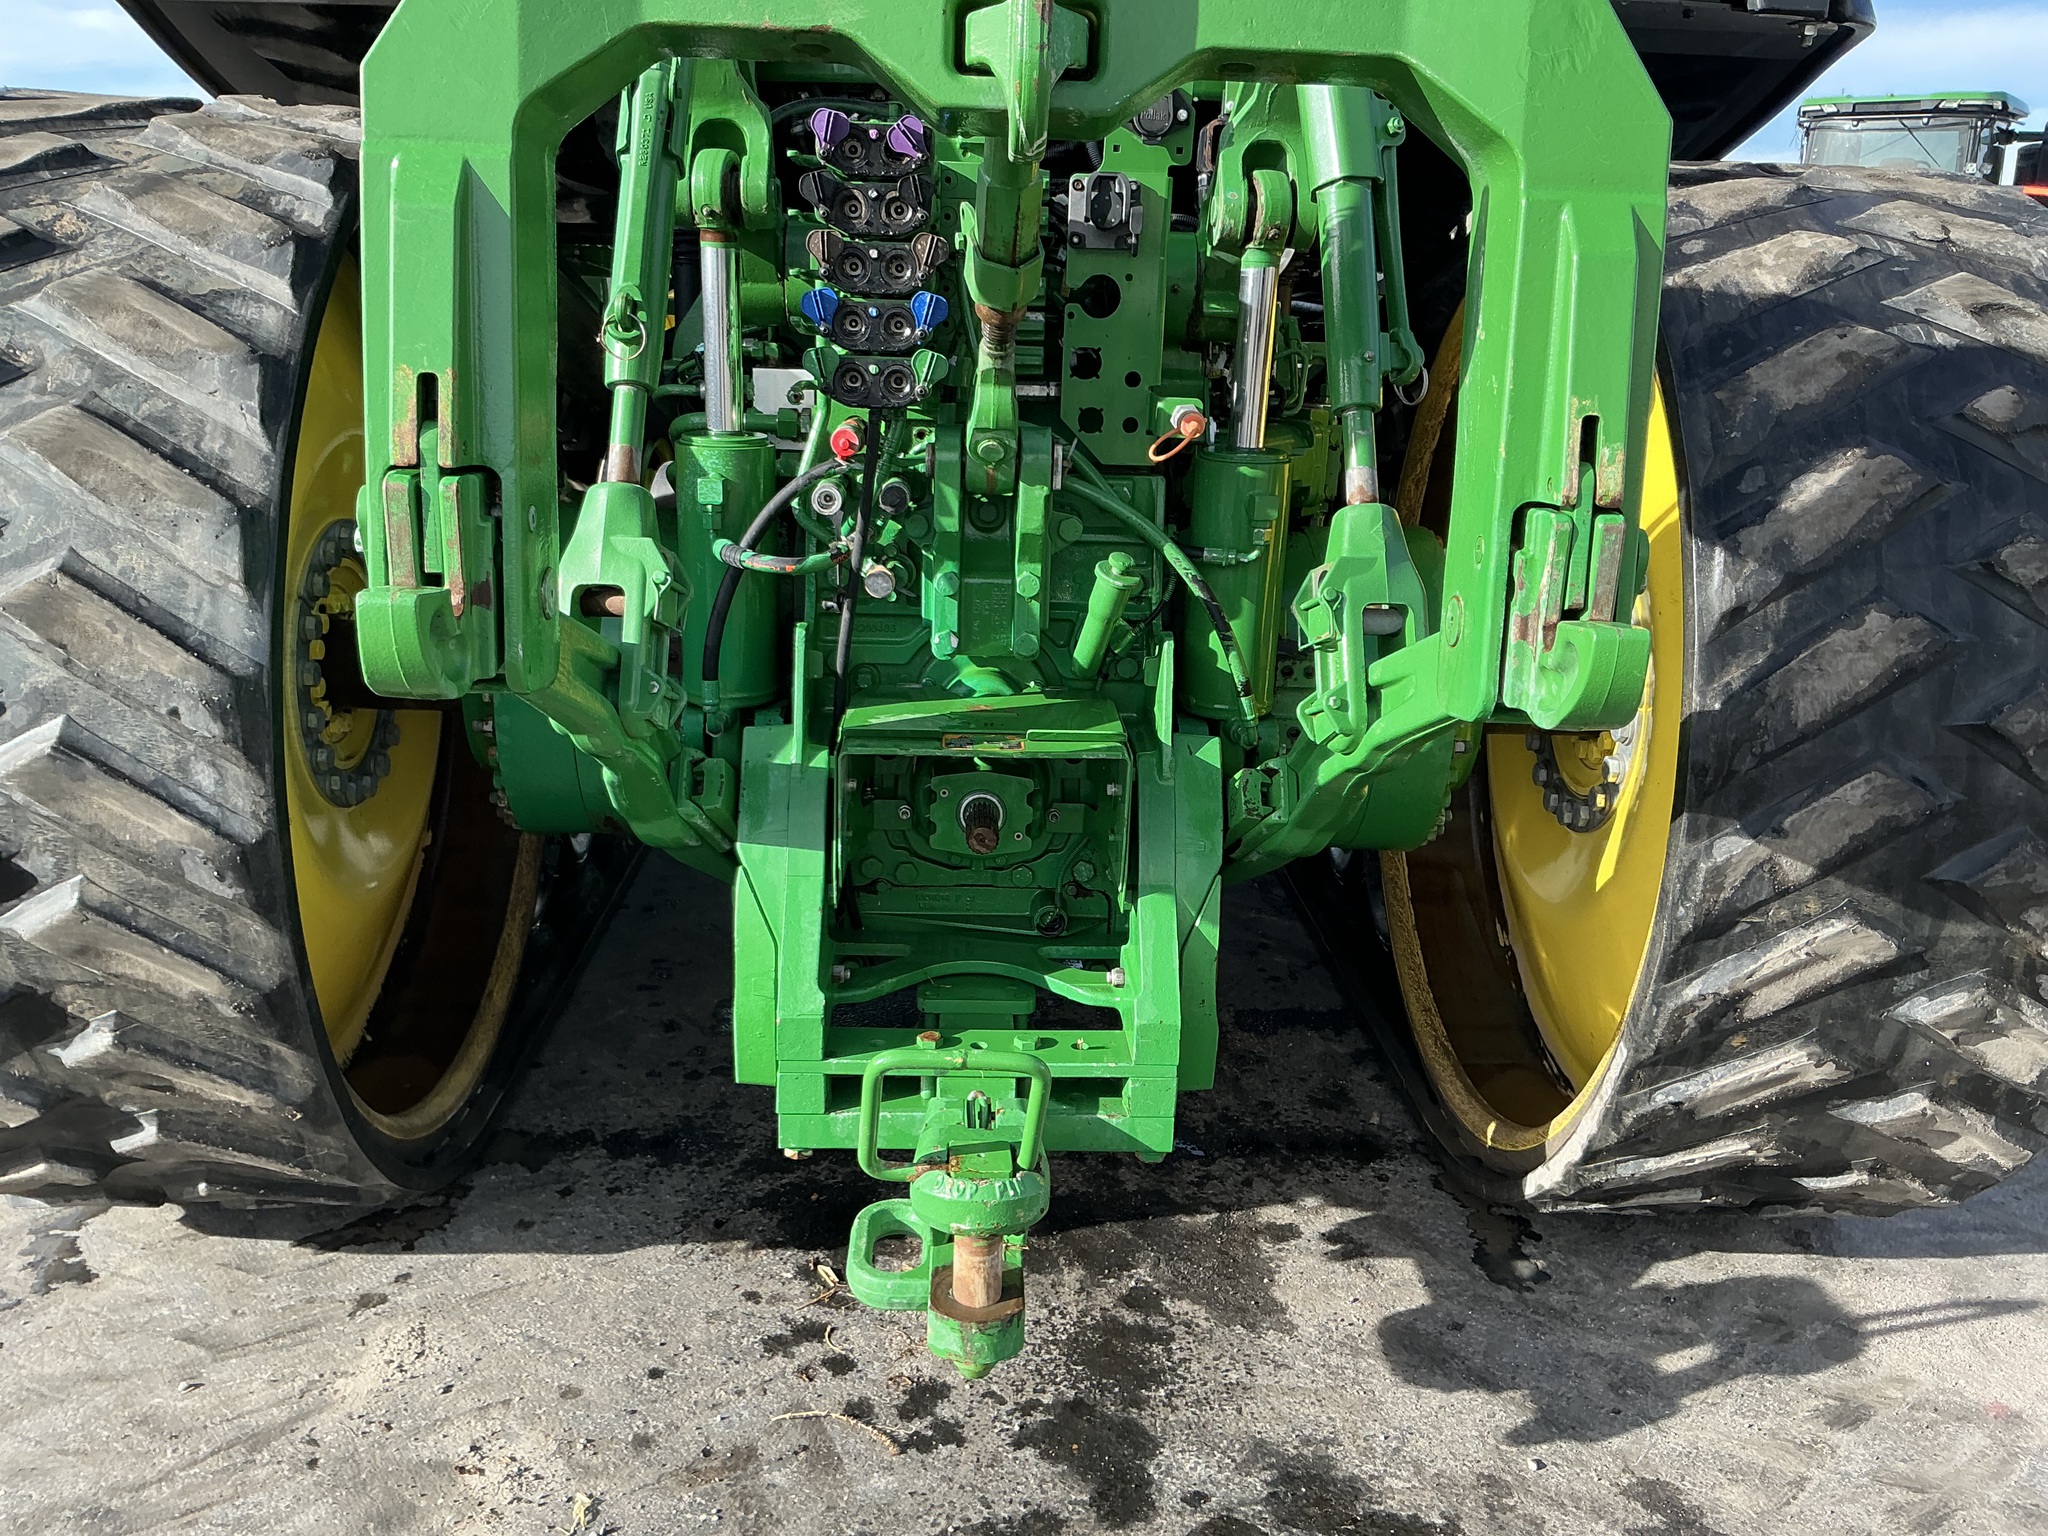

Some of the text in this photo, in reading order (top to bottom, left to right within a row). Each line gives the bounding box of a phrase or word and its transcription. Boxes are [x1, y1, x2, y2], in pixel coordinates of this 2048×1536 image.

[644, 92, 655, 110] USA
[1140, 109, 1166, 121] Pollak
[934, 1174, 1024, 1200] DROP PIN
